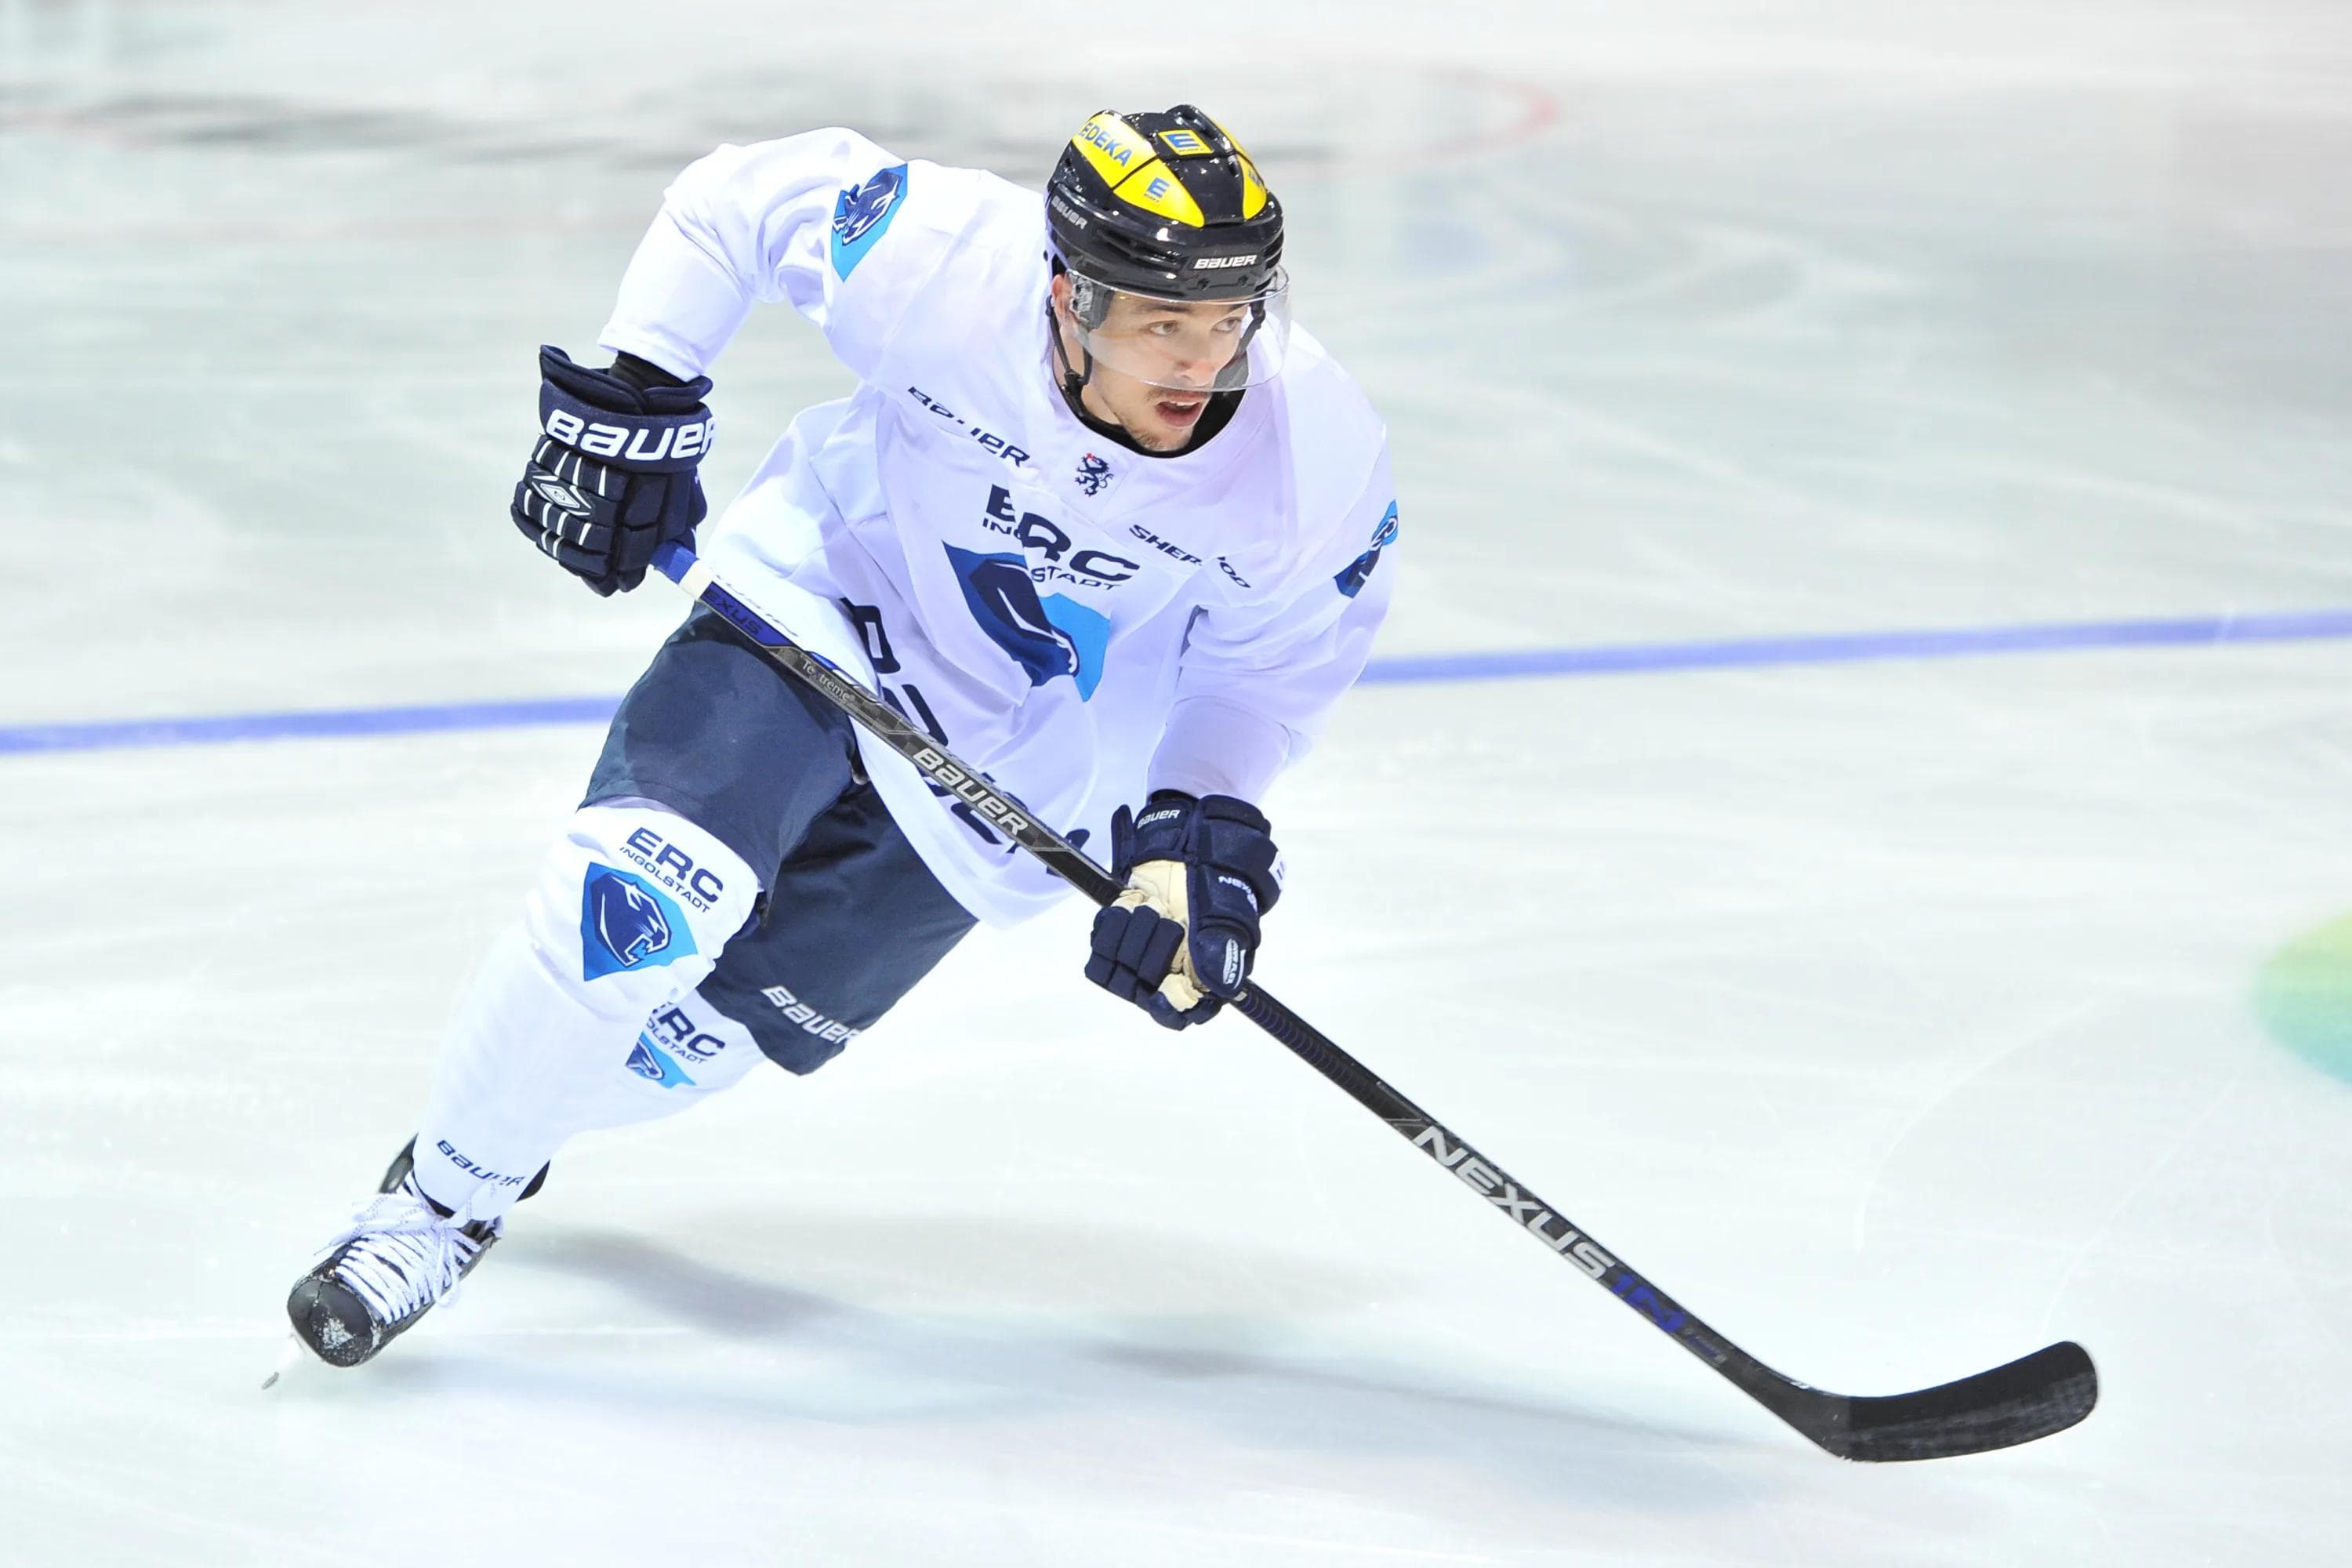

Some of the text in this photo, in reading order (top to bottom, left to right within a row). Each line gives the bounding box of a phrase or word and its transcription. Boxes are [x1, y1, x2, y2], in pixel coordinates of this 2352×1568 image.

[1080, 122, 1133, 167] EDEKA
[1193, 254, 1258, 270] BAUER
[985, 483, 1141, 582] ERC
[704, 587, 763, 638] EXUS
[912, 747, 1029, 837] BAUER
[1137, 809, 1181, 829] BAUER
[619, 847, 710, 914] INGOLSTADT
[626, 826, 724, 903] ERC
[1411, 1125, 1617, 1280] NEXUS
